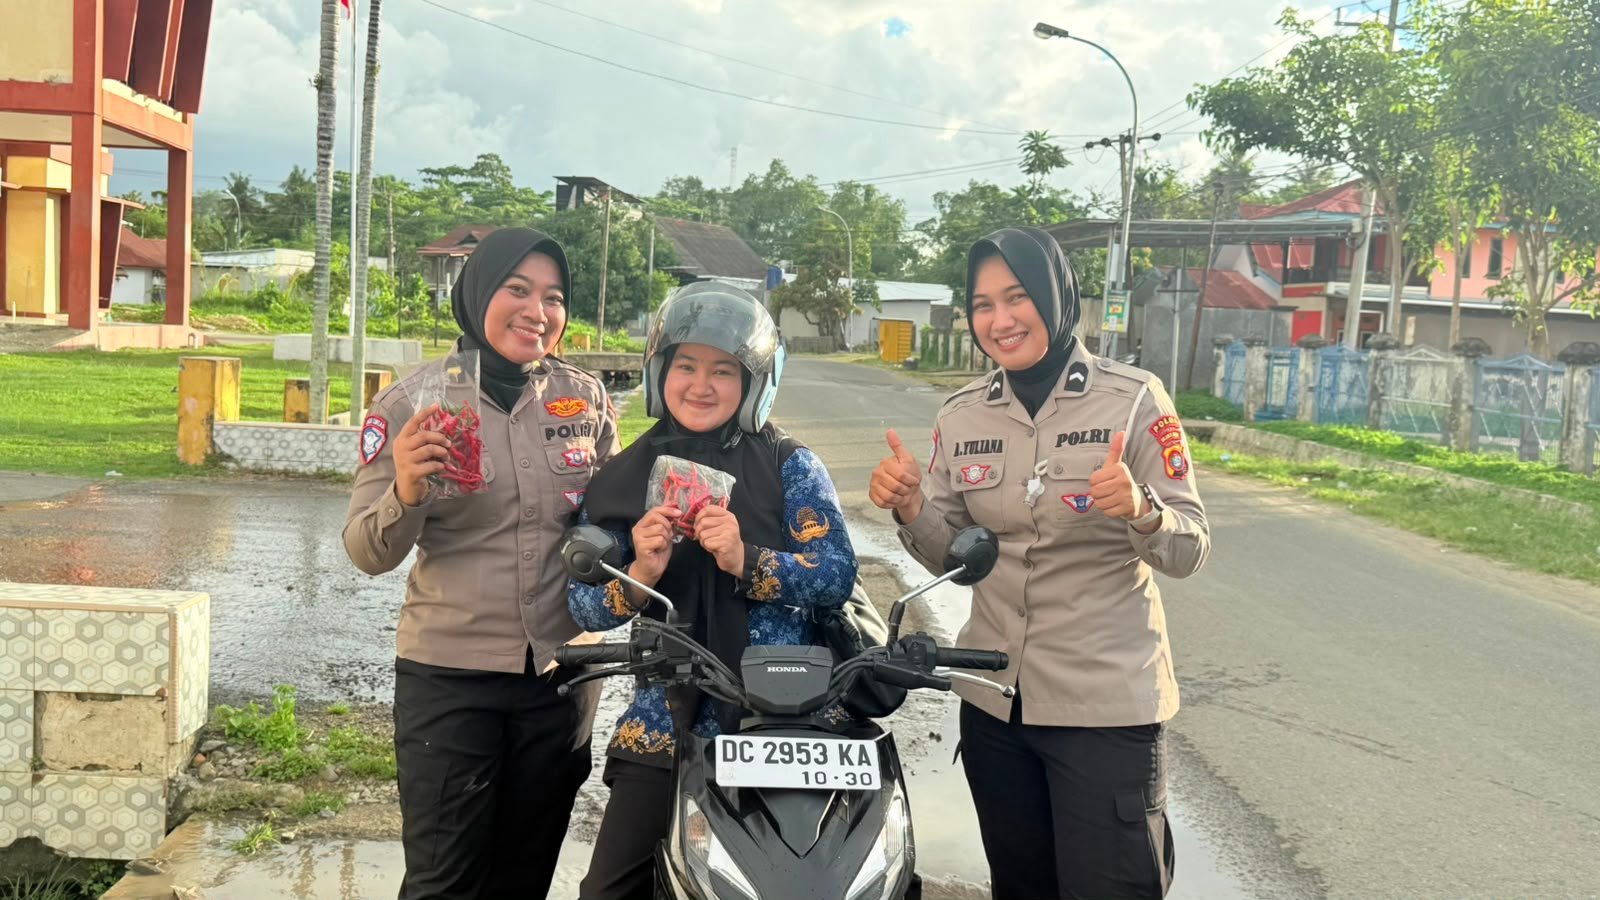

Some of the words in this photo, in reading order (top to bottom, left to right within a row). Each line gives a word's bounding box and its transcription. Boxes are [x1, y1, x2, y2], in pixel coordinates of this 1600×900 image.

[1055, 429, 1111, 447] POLRI
[722, 739, 754, 763] DC
[762, 742, 828, 766] 2953
[838, 743, 872, 766] KA
